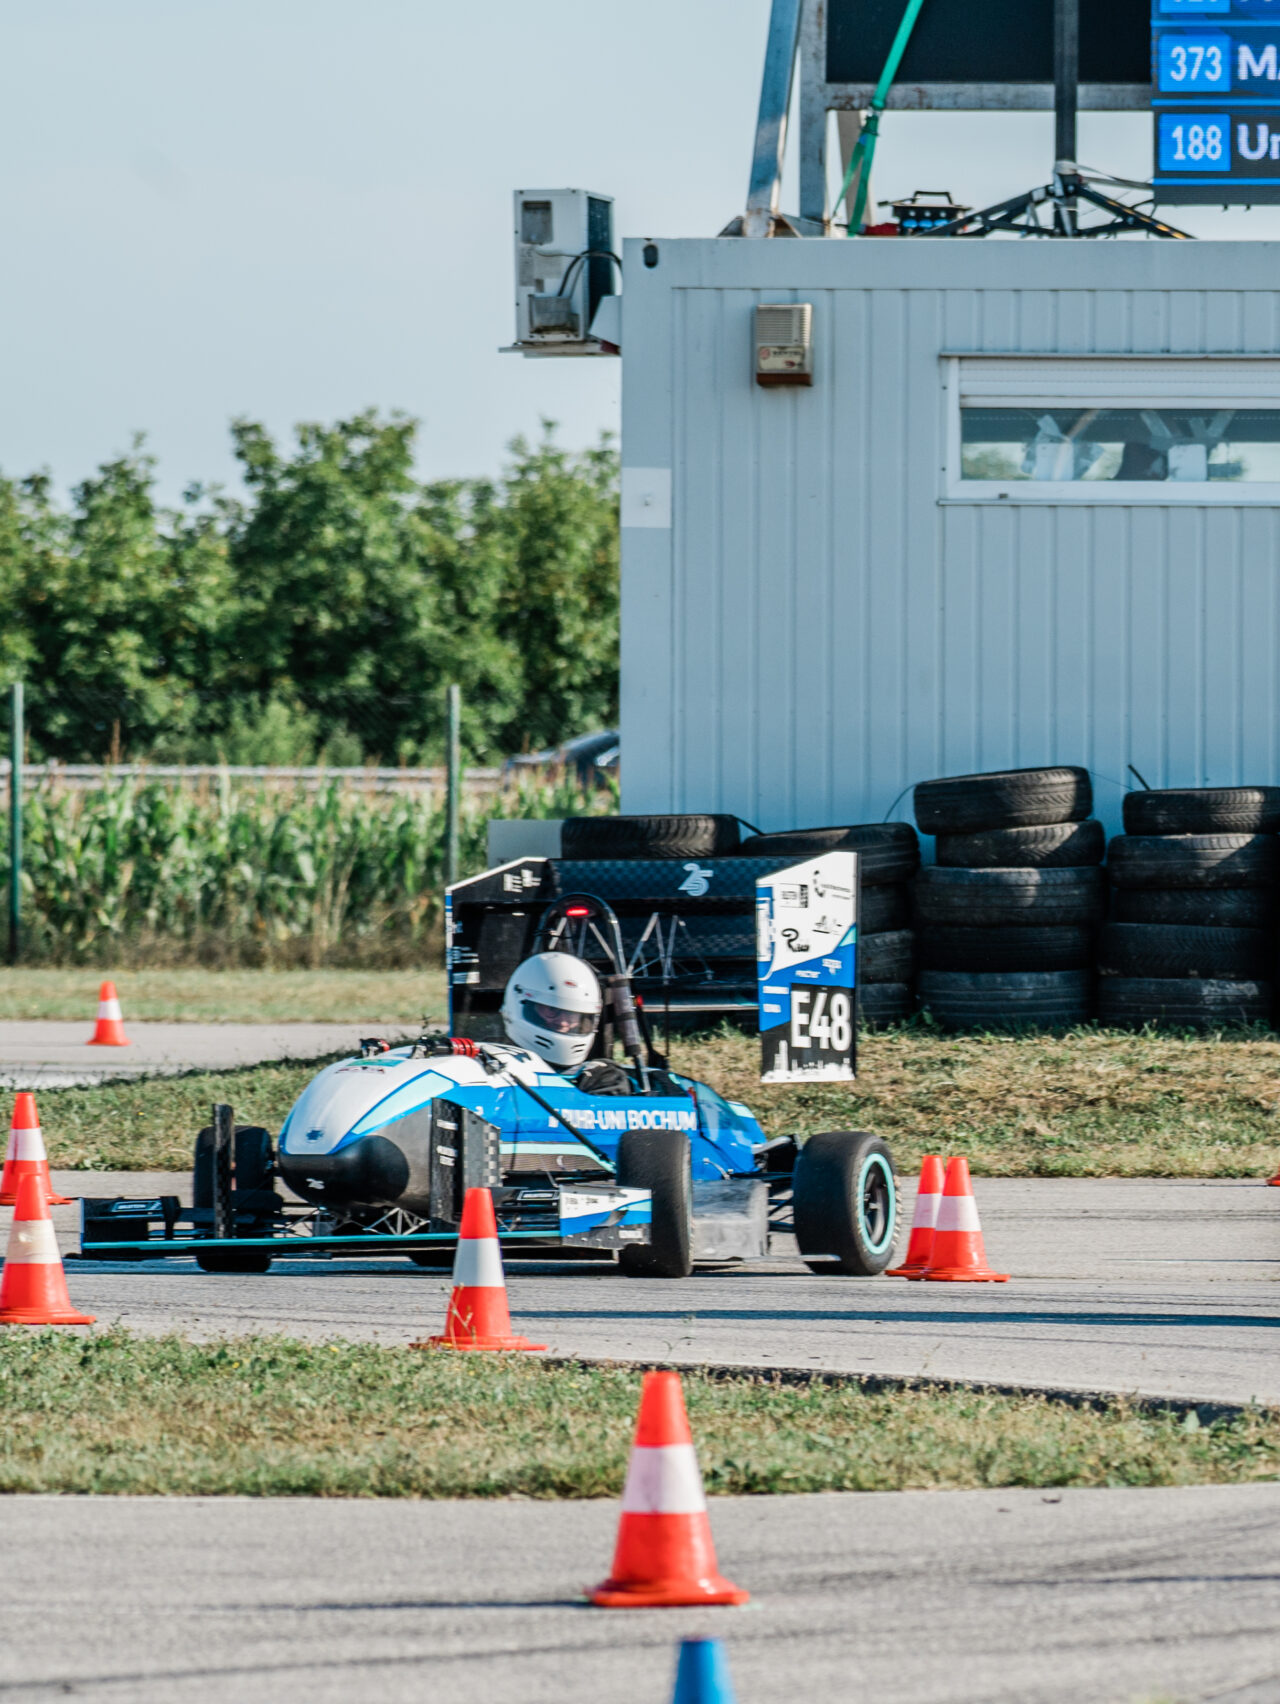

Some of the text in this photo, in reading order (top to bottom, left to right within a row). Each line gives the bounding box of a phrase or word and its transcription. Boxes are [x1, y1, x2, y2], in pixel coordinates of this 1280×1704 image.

[1170, 46, 1222, 81] 373
[1171, 125, 1222, 160] 188
[791, 990, 852, 1051] E48
[627, 1109, 698, 1131] BOCHUM
